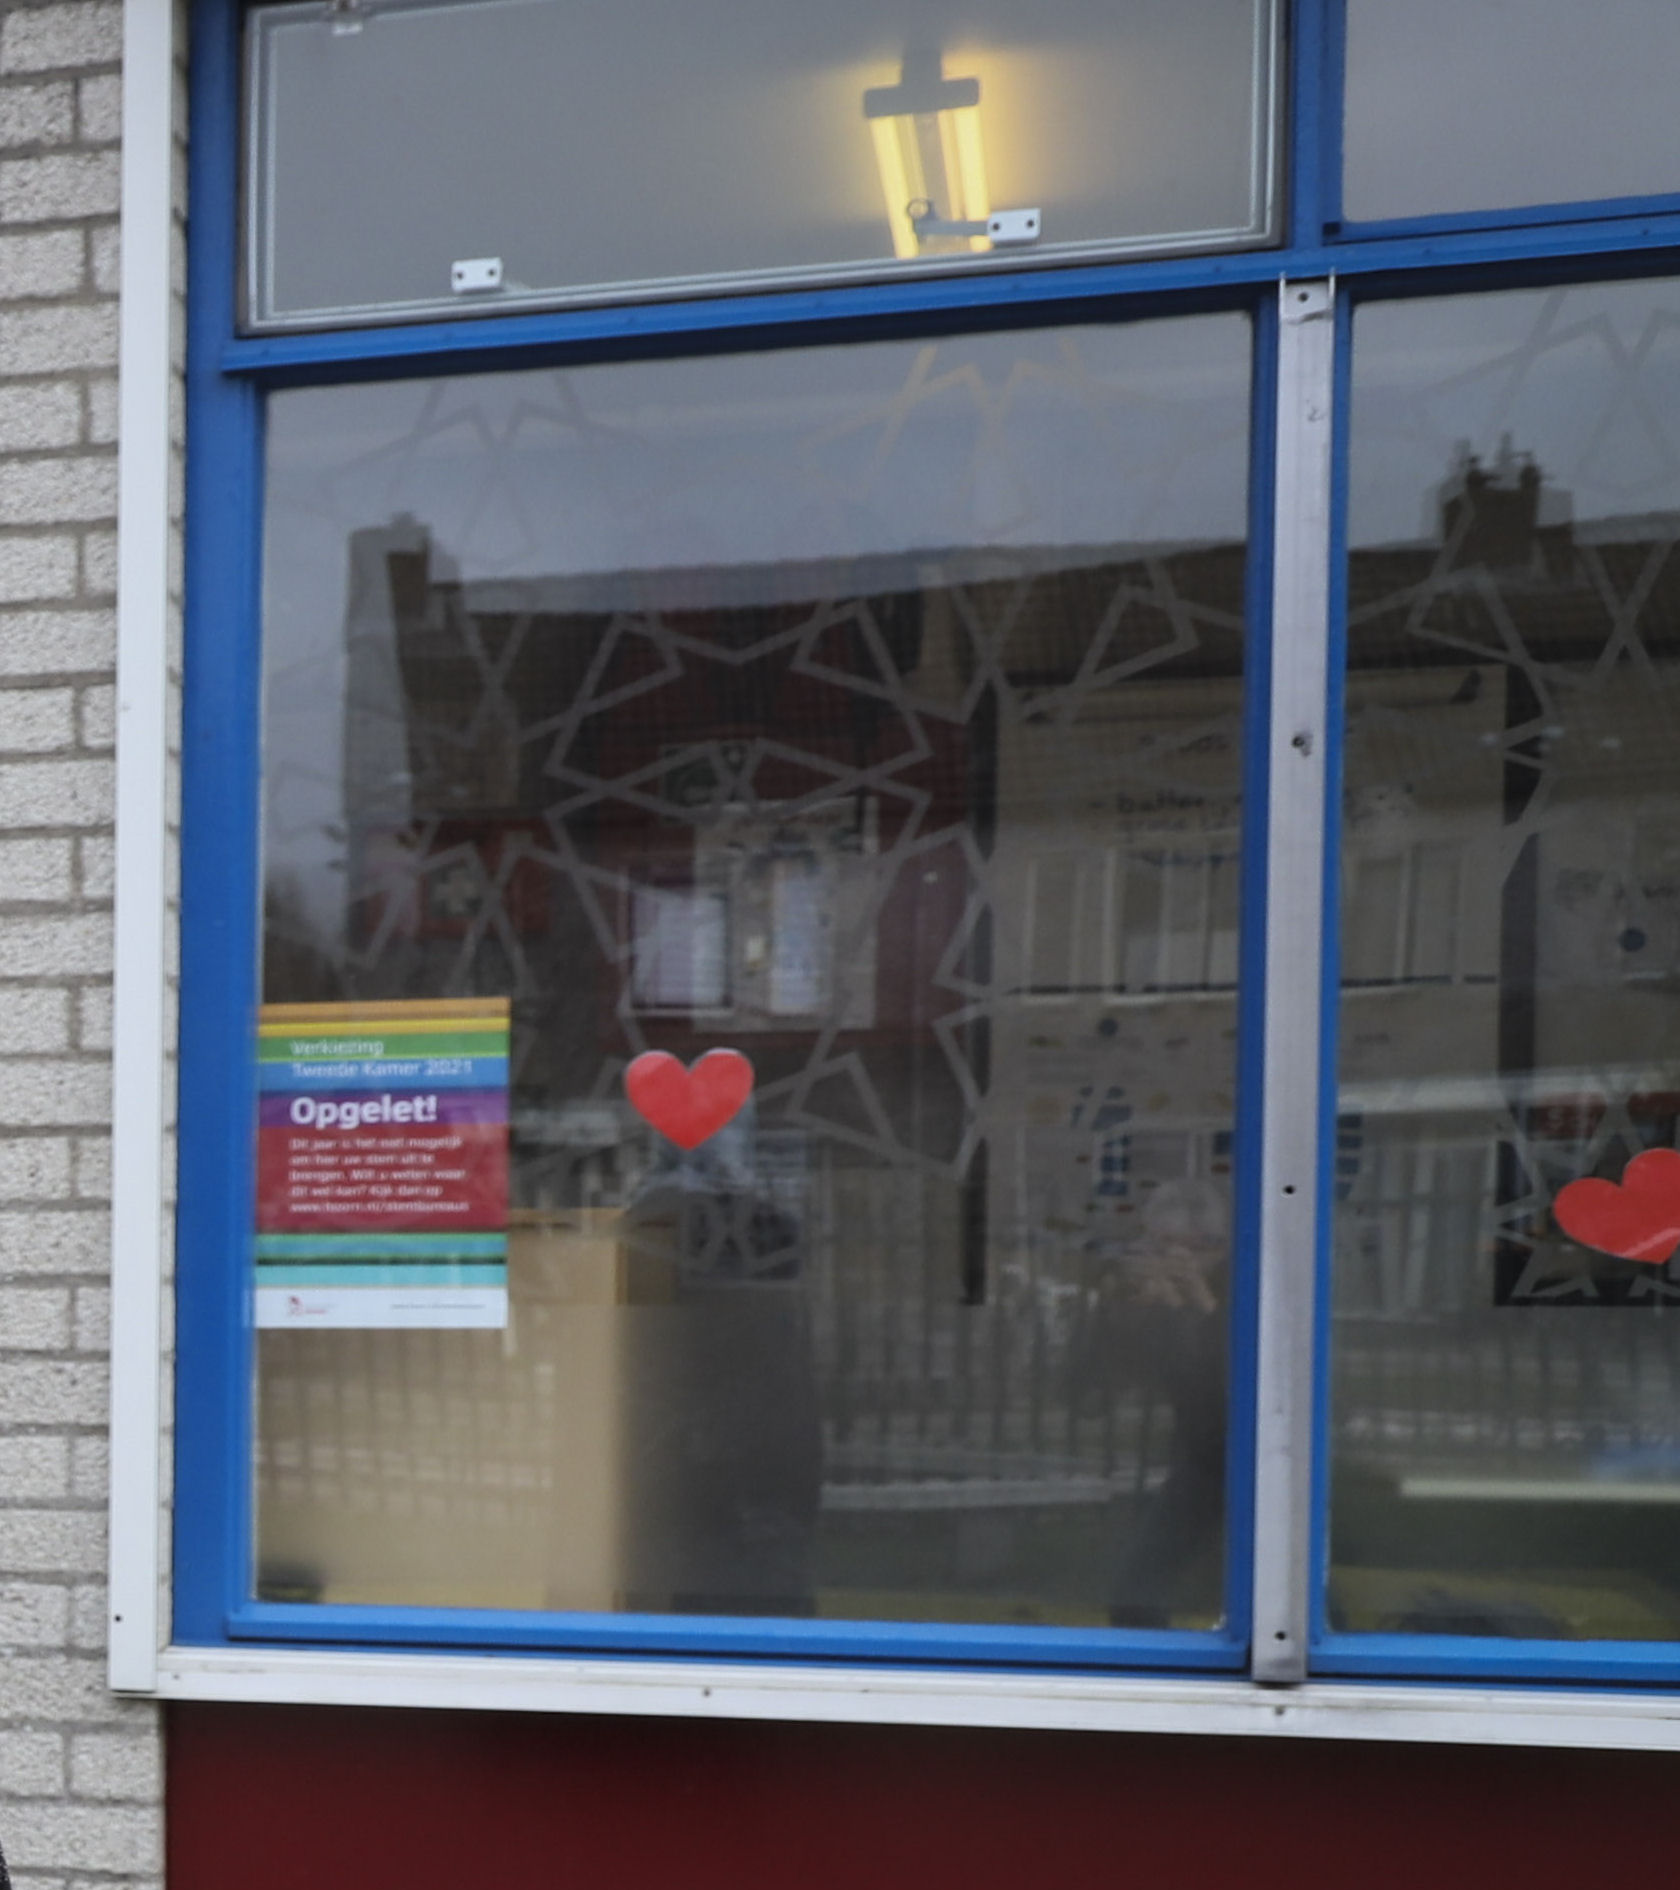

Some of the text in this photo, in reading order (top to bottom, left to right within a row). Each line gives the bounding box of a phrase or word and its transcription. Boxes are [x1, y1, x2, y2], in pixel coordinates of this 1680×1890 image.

[290, 1040, 384, 1059] Verkiezing
[292, 1062, 358, 1078] Tweede
[362, 1060, 420, 1077] Kamer
[290, 1093, 438, 1130] Opgelet!
